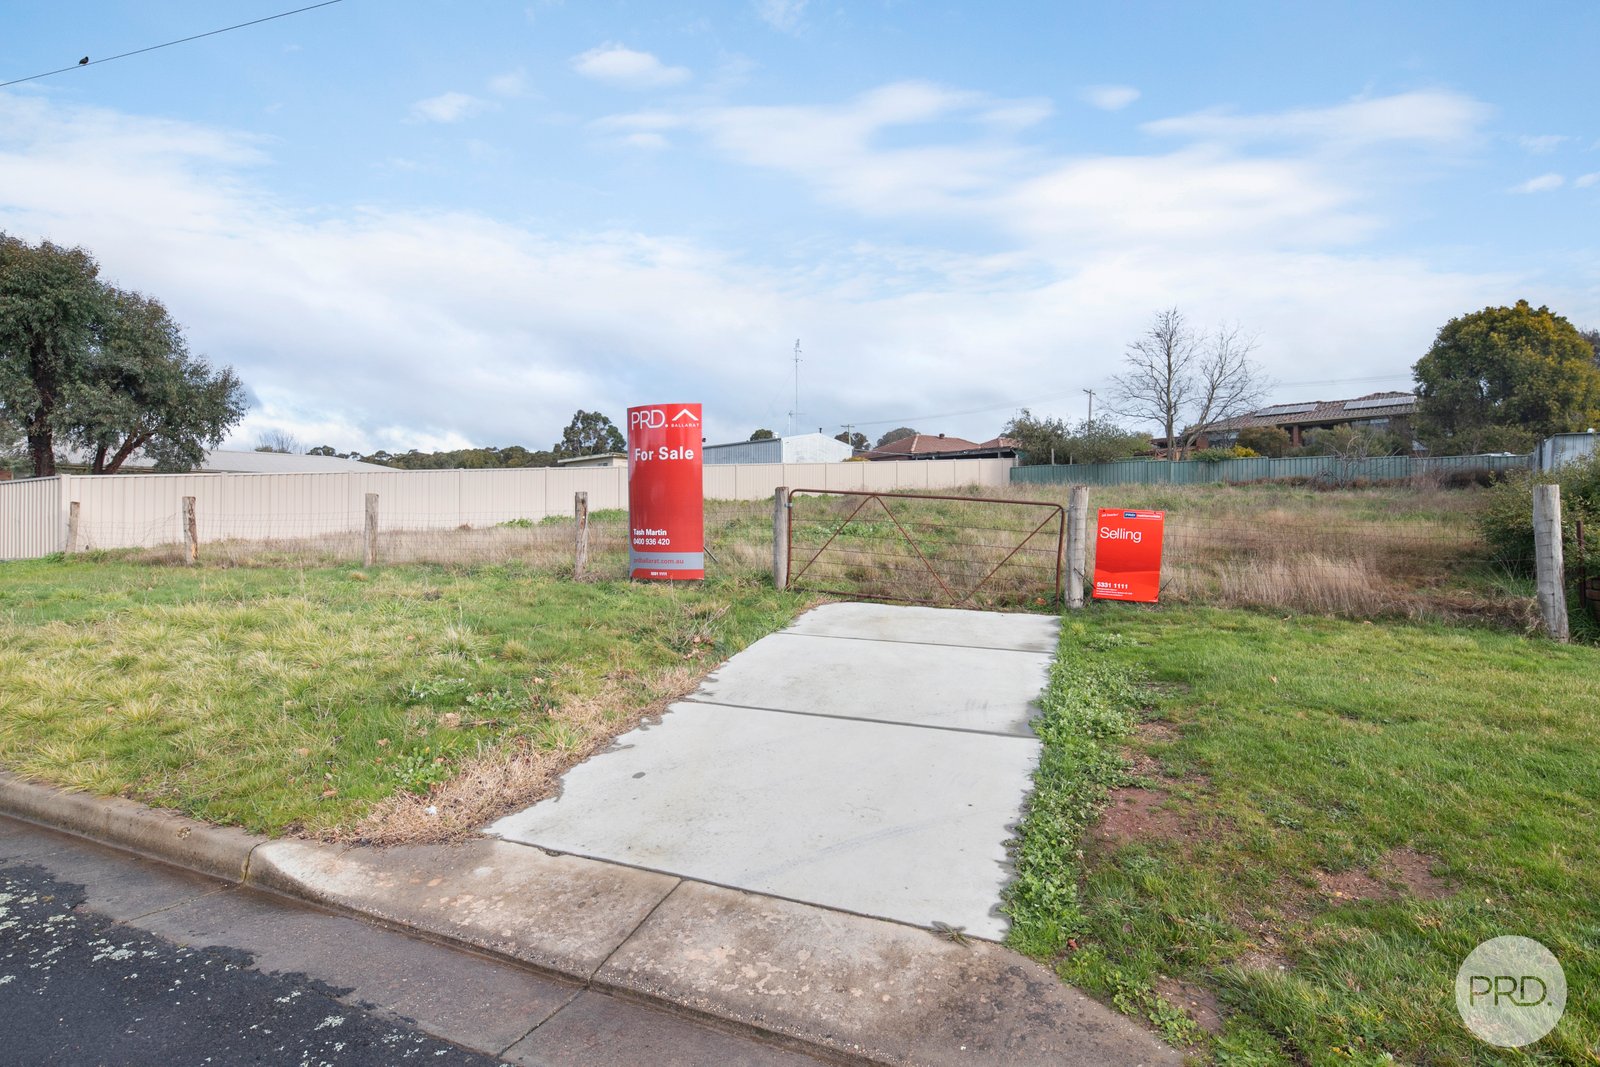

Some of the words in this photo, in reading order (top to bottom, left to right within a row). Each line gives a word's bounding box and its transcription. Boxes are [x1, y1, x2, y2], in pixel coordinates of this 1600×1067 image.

[634, 448, 654, 461] For
[658, 446, 694, 460] Sale
[645, 528, 667, 536] Martin
[1100, 526, 1142, 543] Selling
[657, 538, 670, 546] 420
